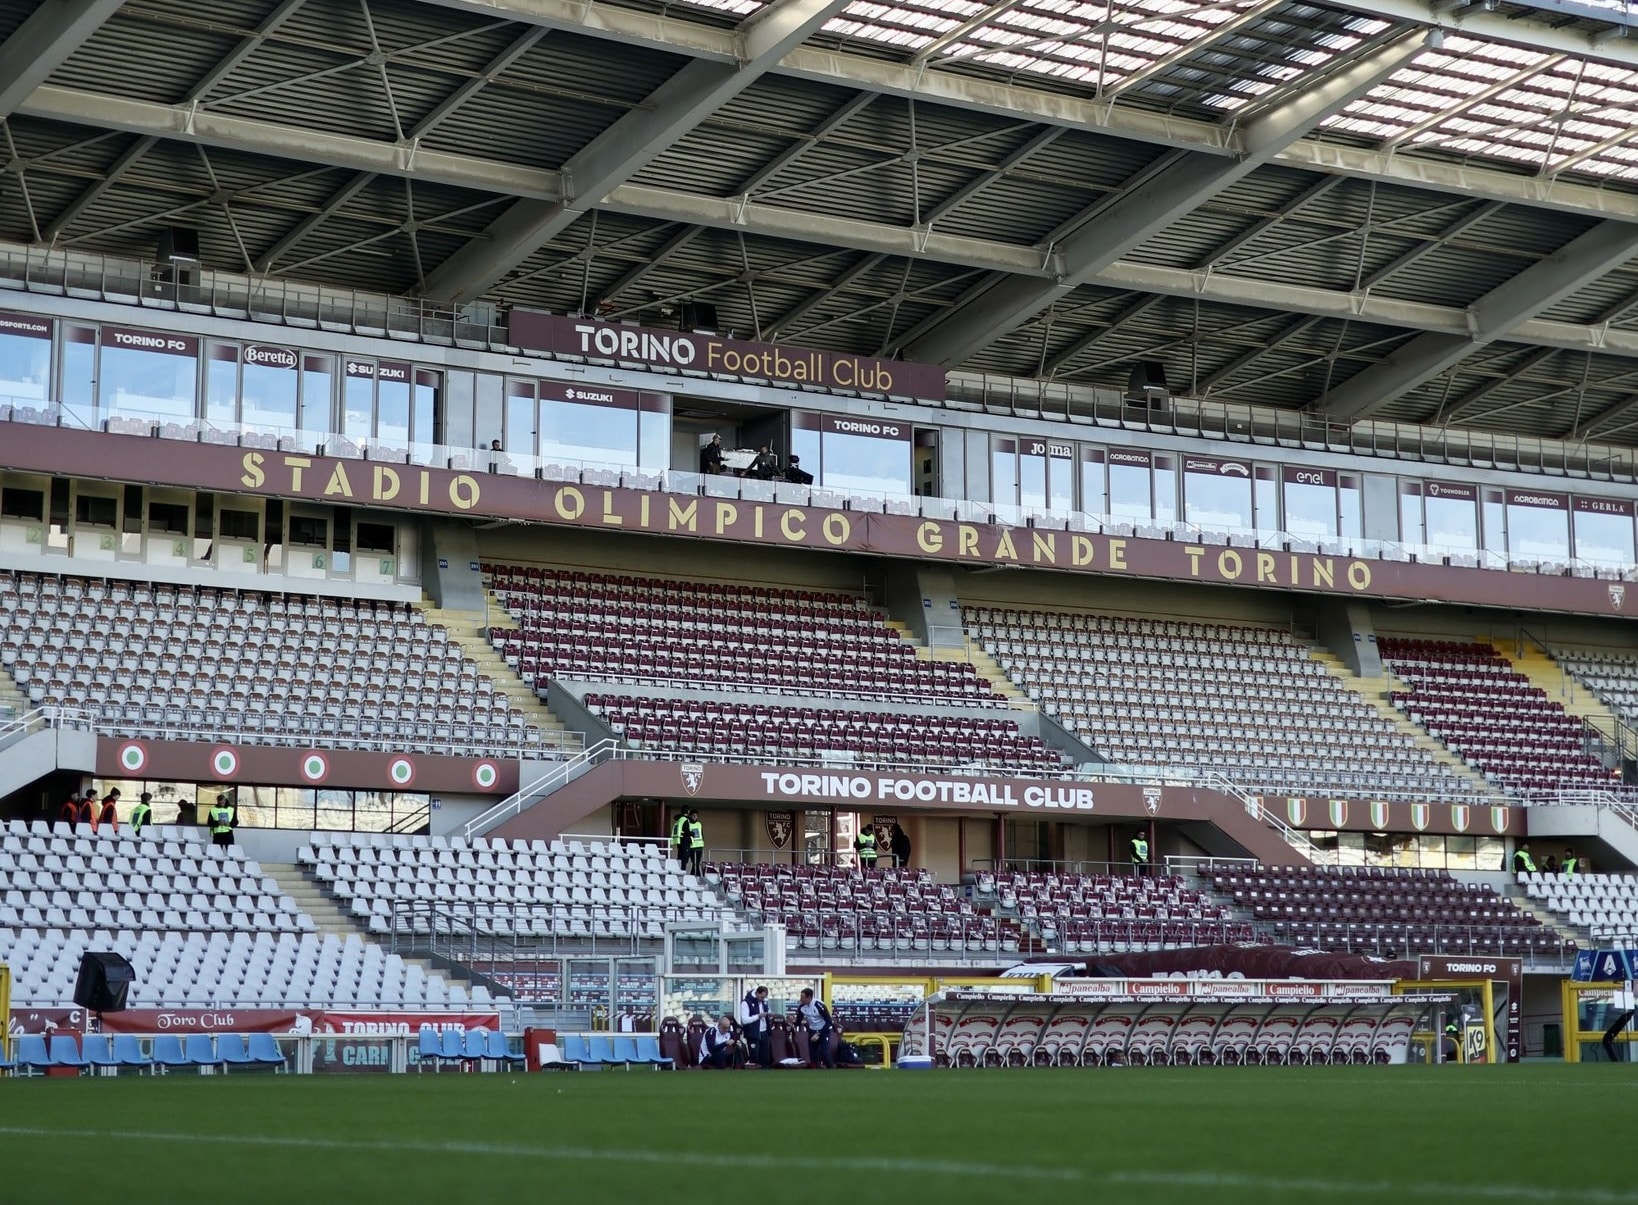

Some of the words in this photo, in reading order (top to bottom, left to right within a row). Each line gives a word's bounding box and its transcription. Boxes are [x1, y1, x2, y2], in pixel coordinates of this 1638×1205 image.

[114, 333, 165, 348] TORINO
[167, 341, 186, 350] FC
[247, 348, 294, 365] Beretta
[575, 325, 695, 365] TORINO
[708, 342, 822, 382] Football
[833, 359, 893, 391] Club
[358, 365, 405, 379] SUZUKI
[576, 391, 613, 403] SUZUKI
[834, 420, 880, 434] TORINO
[883, 426, 899, 436] FC
[1296, 471, 1323, 485] enel
[1592, 501, 1624, 513] GERLA
[241, 452, 480, 509] STADIO
[555, 487, 850, 545] OLIMPICO
[917, 521, 1127, 570] GRANDE
[1185, 547, 1371, 590] TORINO
[103, 535, 113, 550] 3
[175, 543, 184, 556] 4
[246, 548, 254, 562] 5
[315, 555, 323, 568] 6
[383, 560, 391, 574] 7
[761, 772, 872, 798] TORINO
[878, 778, 1018, 806] FOOTBALL
[1024, 787, 1094, 809] CLUB
[1446, 963, 1482, 973] TORINO
[1483, 963, 1496, 973] FC
[1071, 982, 1111, 994] panealba
[1132, 982, 1180, 995] Campiello
[1213, 983, 1249, 994] panealba
[1270, 984, 1315, 996] Campiello
[1345, 984, 1380, 995] panealba
[157, 1013, 197, 1029] Toro
[200, 1013, 234, 1029] Club
[1469, 1029, 1484, 1057] K9
